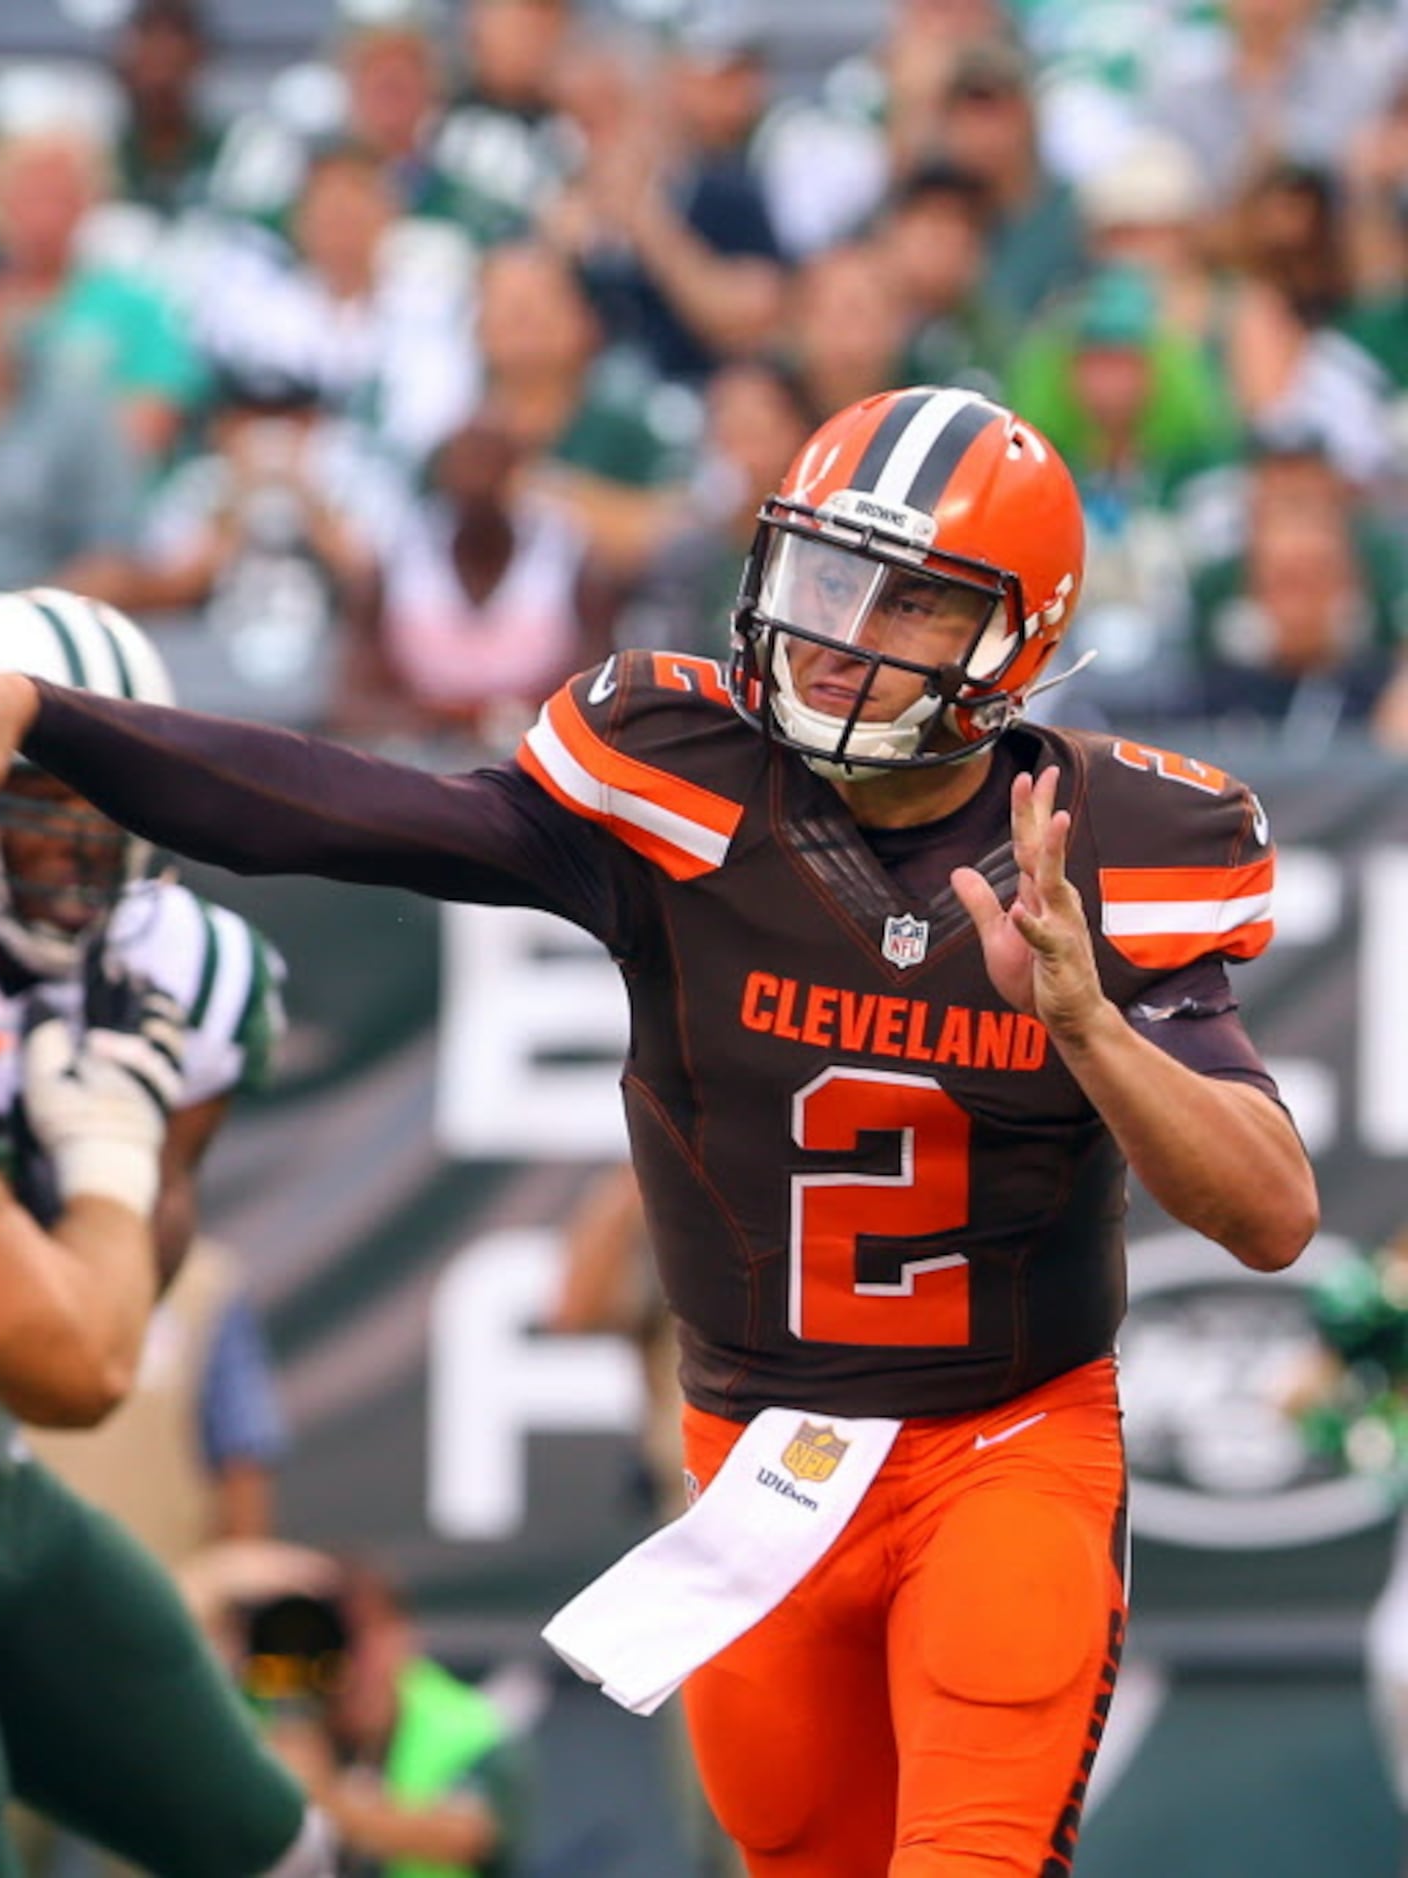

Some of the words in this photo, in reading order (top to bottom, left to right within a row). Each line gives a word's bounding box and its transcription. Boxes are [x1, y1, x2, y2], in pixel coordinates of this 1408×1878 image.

[854, 499, 910, 529] BROWNS
[1112, 740, 1228, 797] 2
[740, 970, 1049, 1072] CLEVELAND
[786, 1064, 973, 1348] 2
[756, 1465, 819, 1513] Wilson
